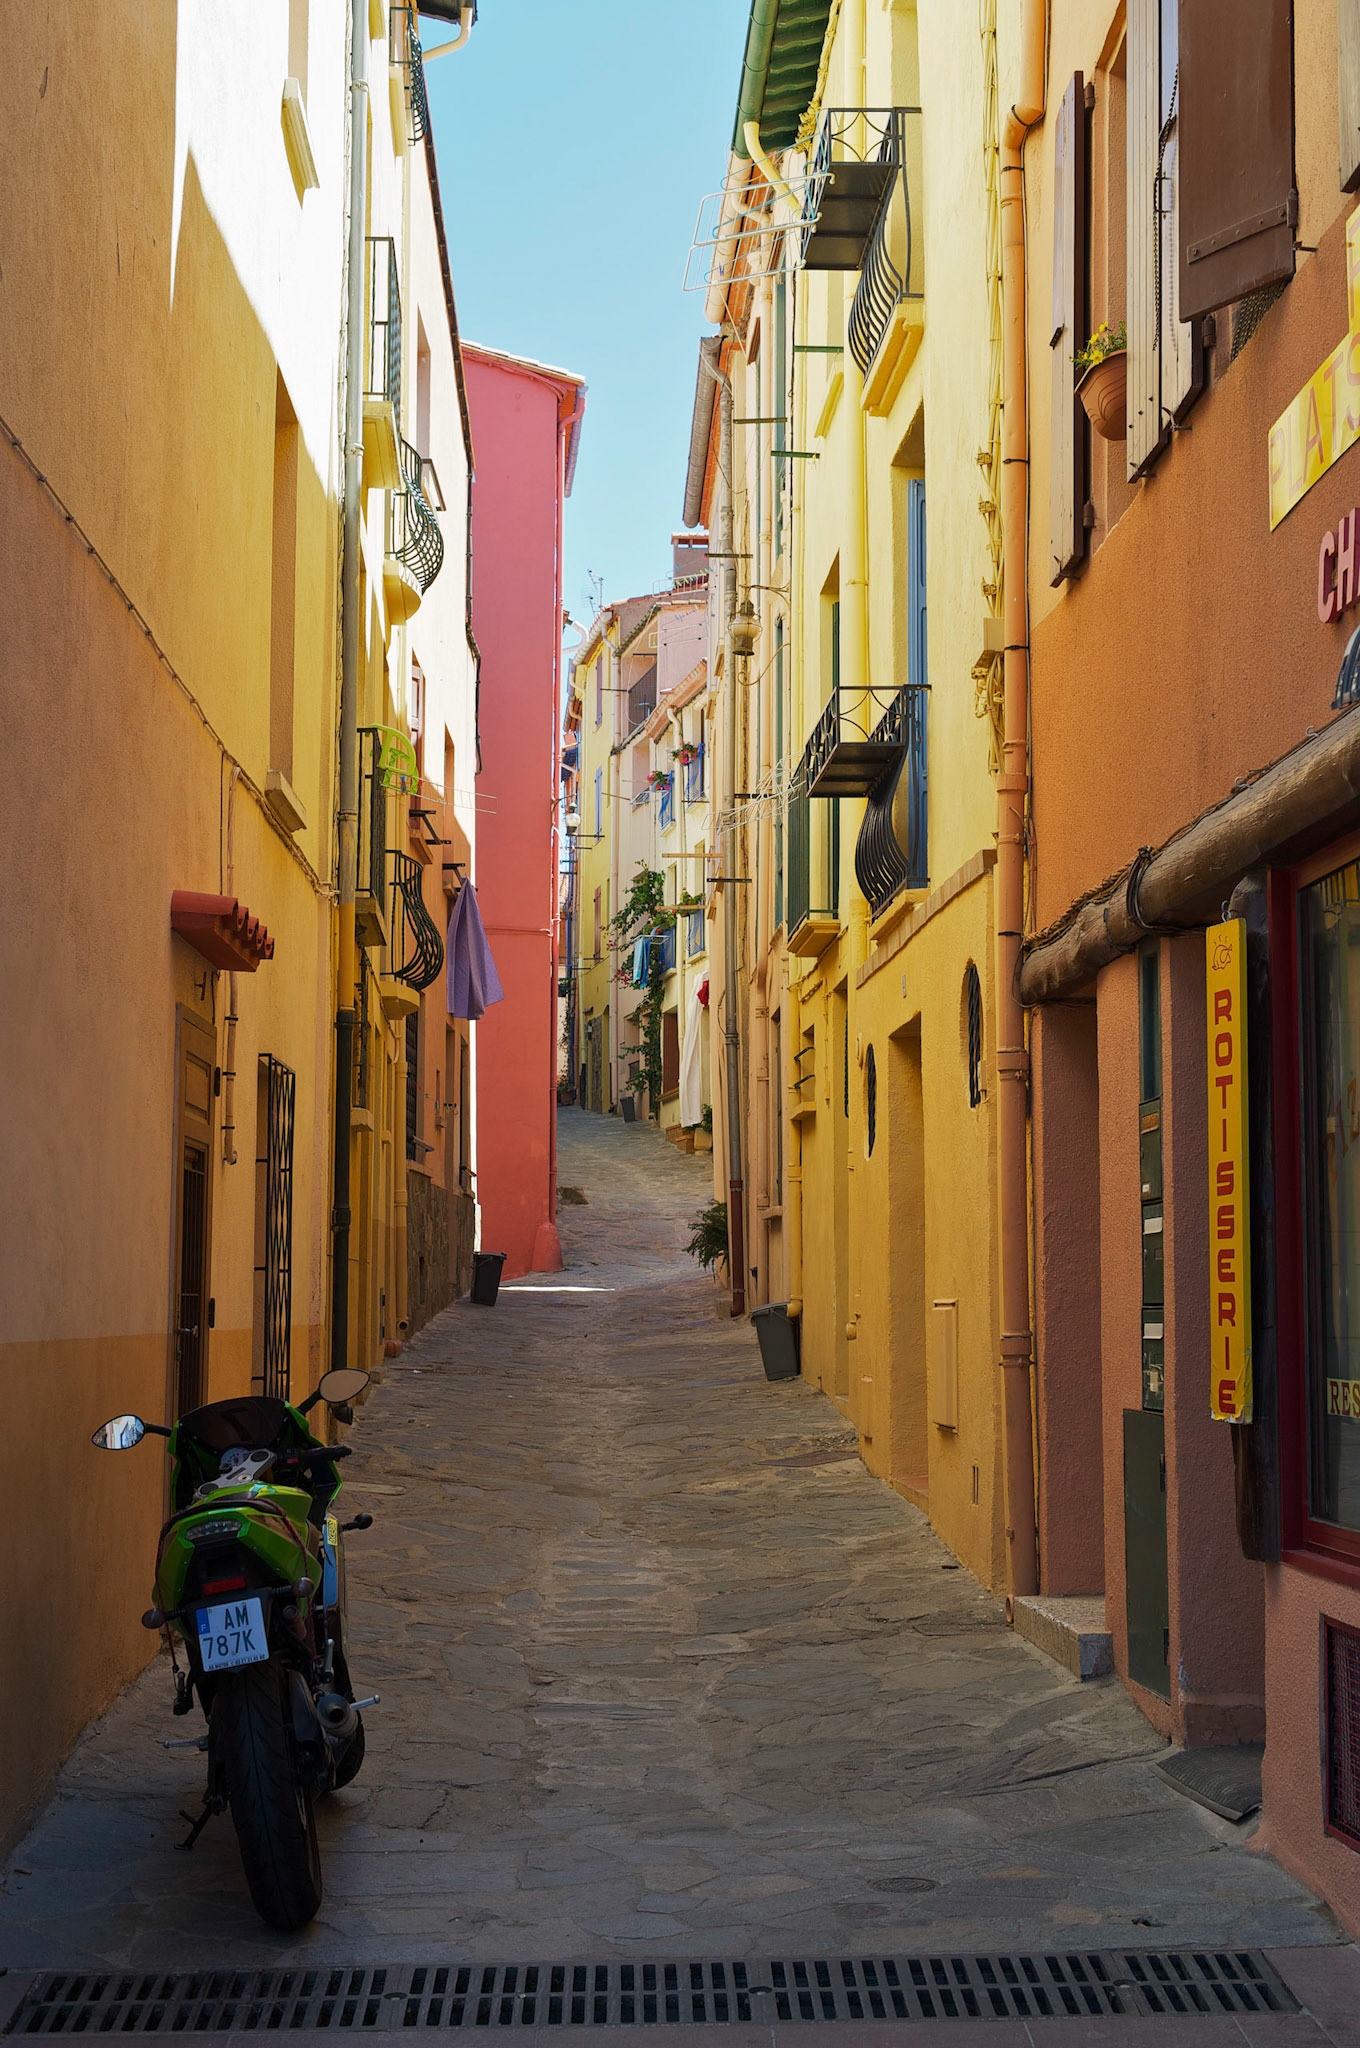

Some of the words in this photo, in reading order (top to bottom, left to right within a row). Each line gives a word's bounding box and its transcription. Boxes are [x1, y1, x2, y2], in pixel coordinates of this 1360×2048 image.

[1317, 507, 1360, 623] CH
[1214, 988, 1236, 1415] ROTISSERIE
[1330, 1380, 1360, 1418] RES
[225, 1604, 249, 1630] AM
[202, 1628, 256, 1659] 787K
